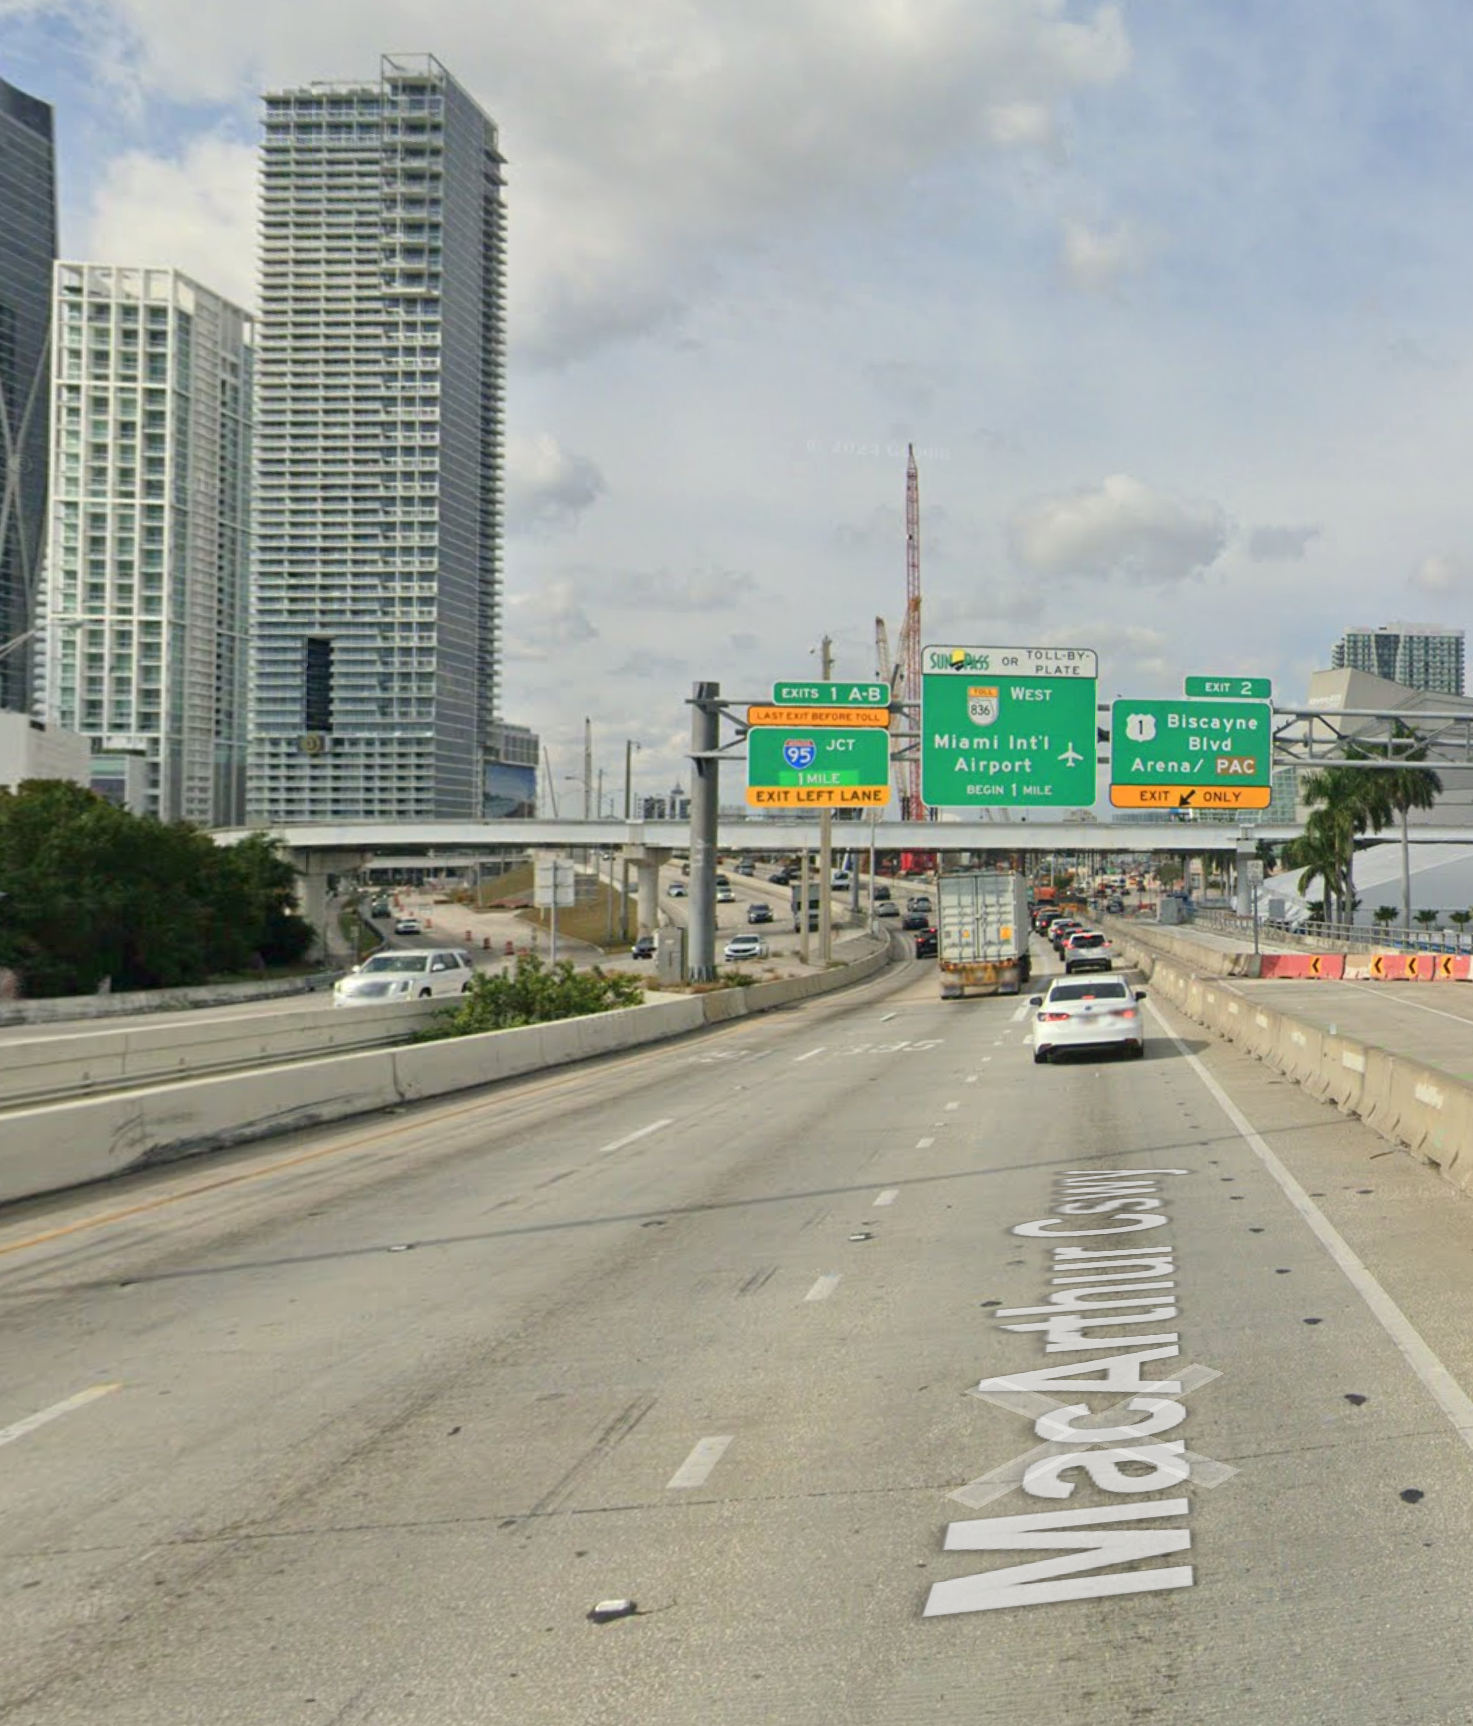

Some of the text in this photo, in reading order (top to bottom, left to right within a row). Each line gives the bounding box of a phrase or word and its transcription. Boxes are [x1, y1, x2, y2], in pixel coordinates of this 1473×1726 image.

[1001, 657, 1019, 667] OR
[1035, 665, 1080, 675] PLATE
[781, 687, 881, 701] EXITS 1 A-B
[1205, 681, 1252, 695] EXIT 2
[756, 712, 880, 721] LAST EXIT BEFORE TOLL
[970, 704, 991, 717] 836
[1137, 719, 1144, 735] 1
[1167, 713, 1258, 733] Biscayne
[826, 739, 856, 751] JCT
[934, 733, 1050, 750] Miami Int'l
[1188, 736, 1232, 751] Blvd
[787, 747, 812, 764] 95
[954, 757, 1032, 776] Airport
[1130, 757, 1256, 774] Arena/ PAC
[798, 772, 841, 785] 1 MILE
[755, 790, 883, 802] EXIT LEFT LANE
[966, 783, 1053, 797] BEGIN 1 MILE
[1139, 790, 1242, 802] EXIT ONLY
